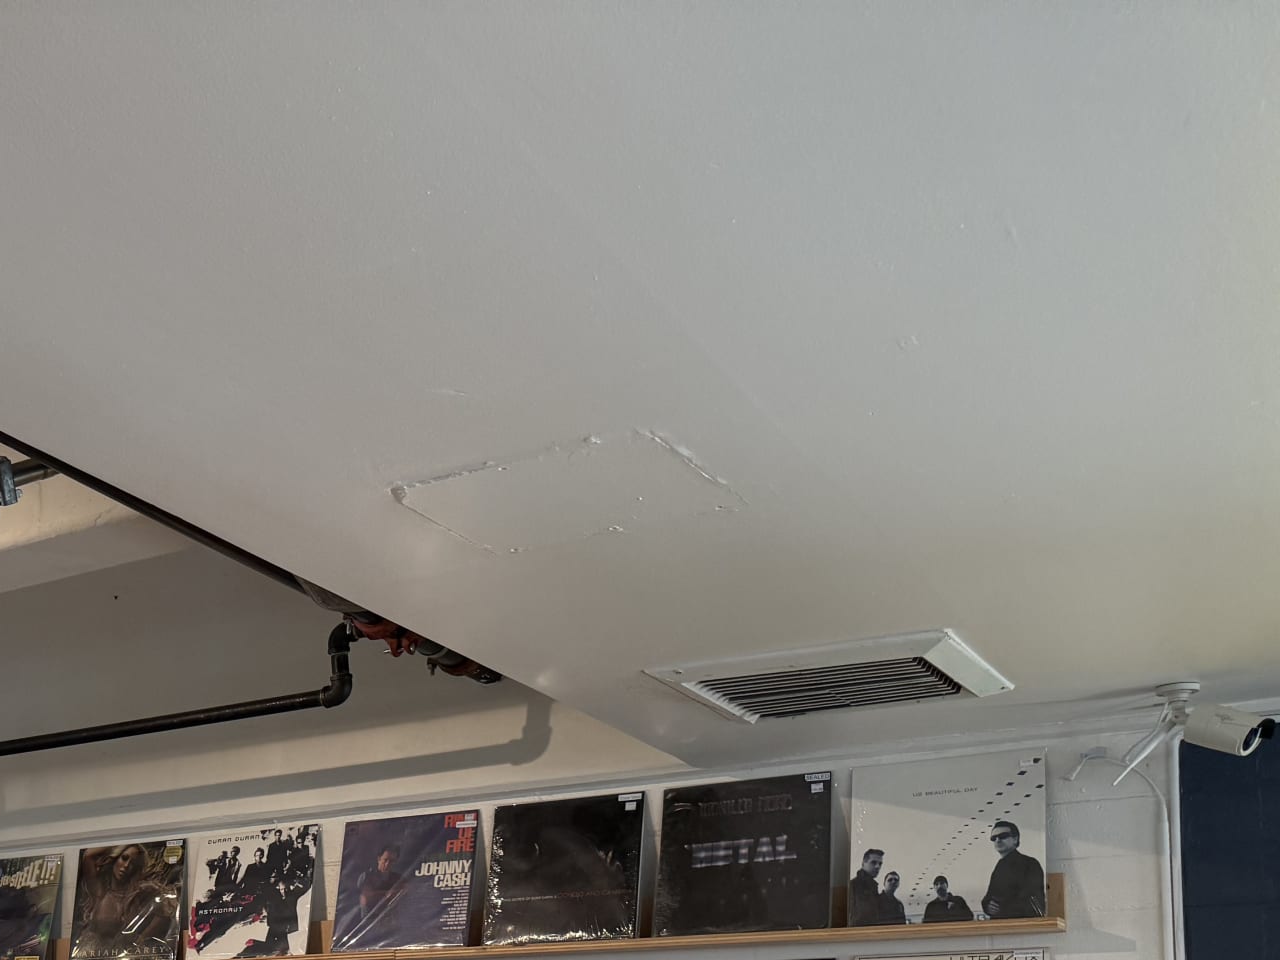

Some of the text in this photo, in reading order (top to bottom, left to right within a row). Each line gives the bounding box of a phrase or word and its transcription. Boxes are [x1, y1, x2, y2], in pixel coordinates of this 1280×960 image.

[207, 834, 261, 845] DURAN DURAN
[445, 839, 474, 854] FIRE
[415, 860, 472, 876] JOHNNY
[434, 873, 471, 888] CASH
[198, 906, 244, 916] ASTRONAUT
